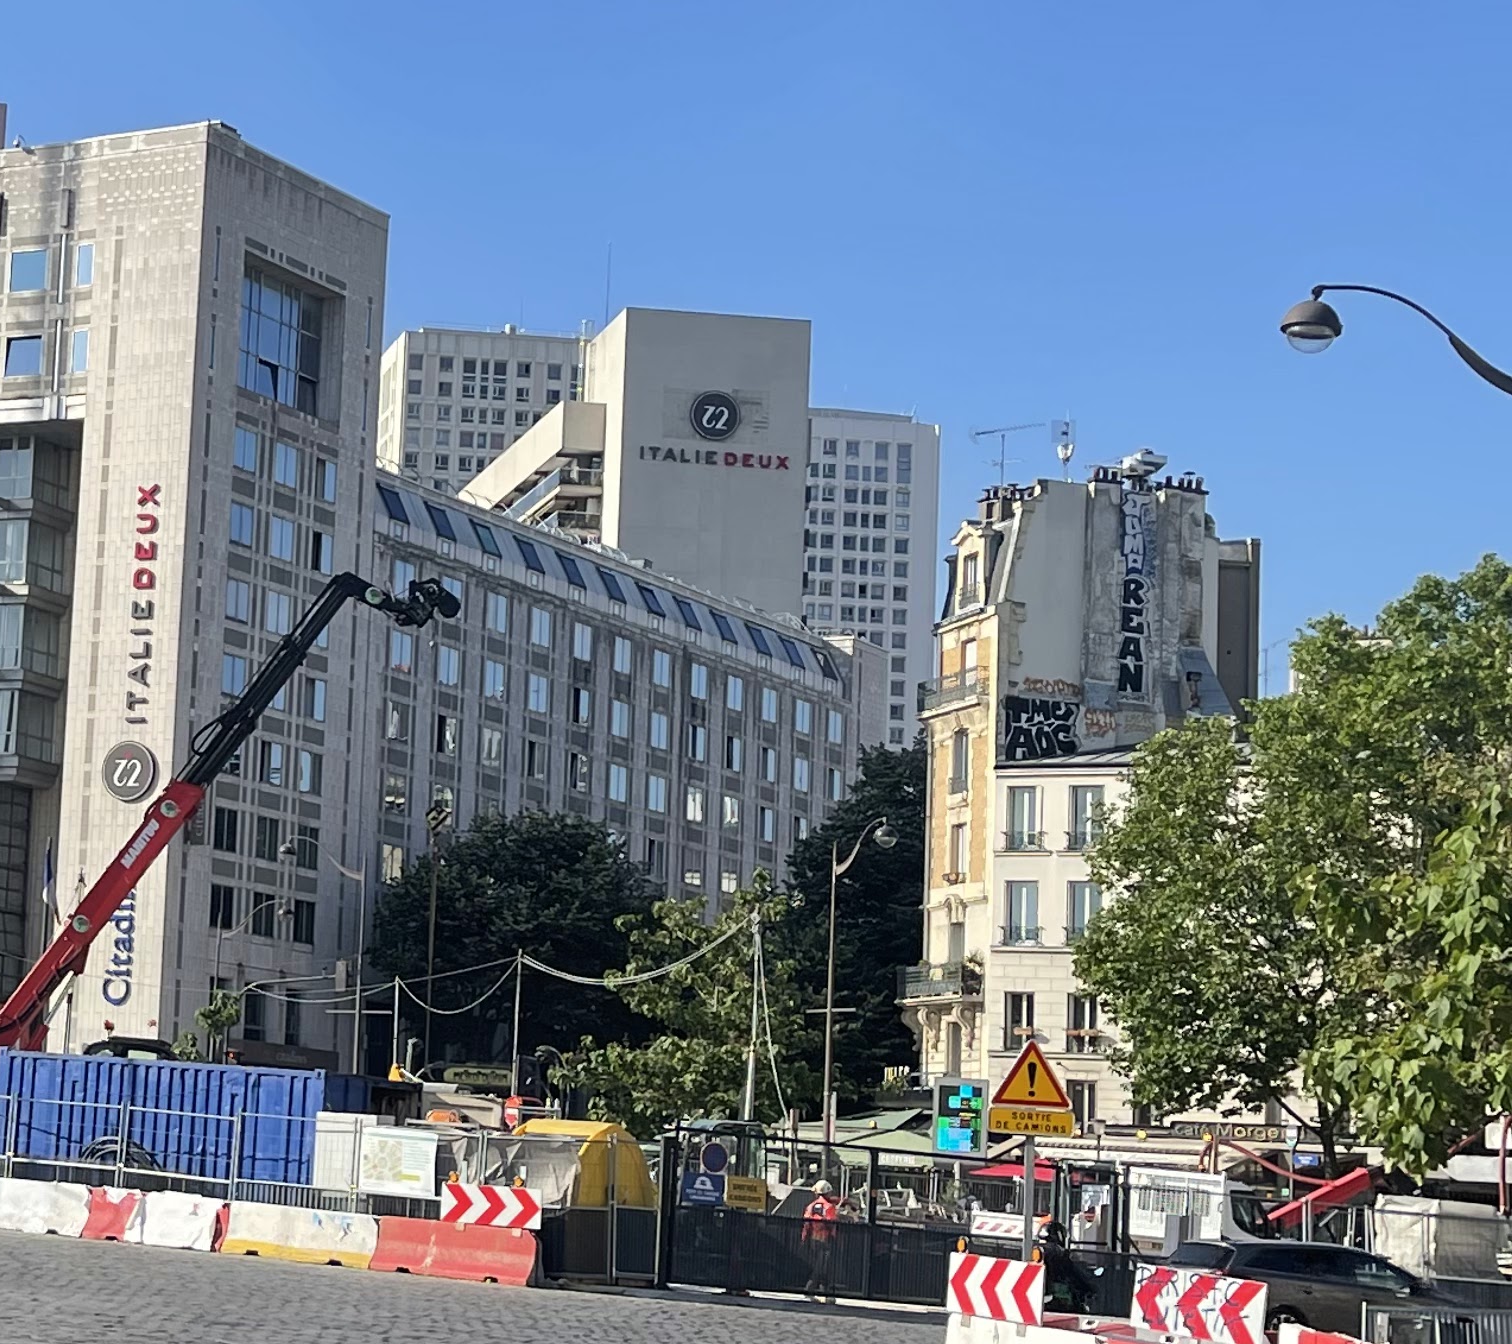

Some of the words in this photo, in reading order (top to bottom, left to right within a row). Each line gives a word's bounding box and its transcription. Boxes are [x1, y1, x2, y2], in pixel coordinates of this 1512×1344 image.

[1011, 1110, 1053, 1123] SORTIE
[995, 1119, 1010, 1130] DE
[1015, 1121, 1068, 1134] CAMIONS
